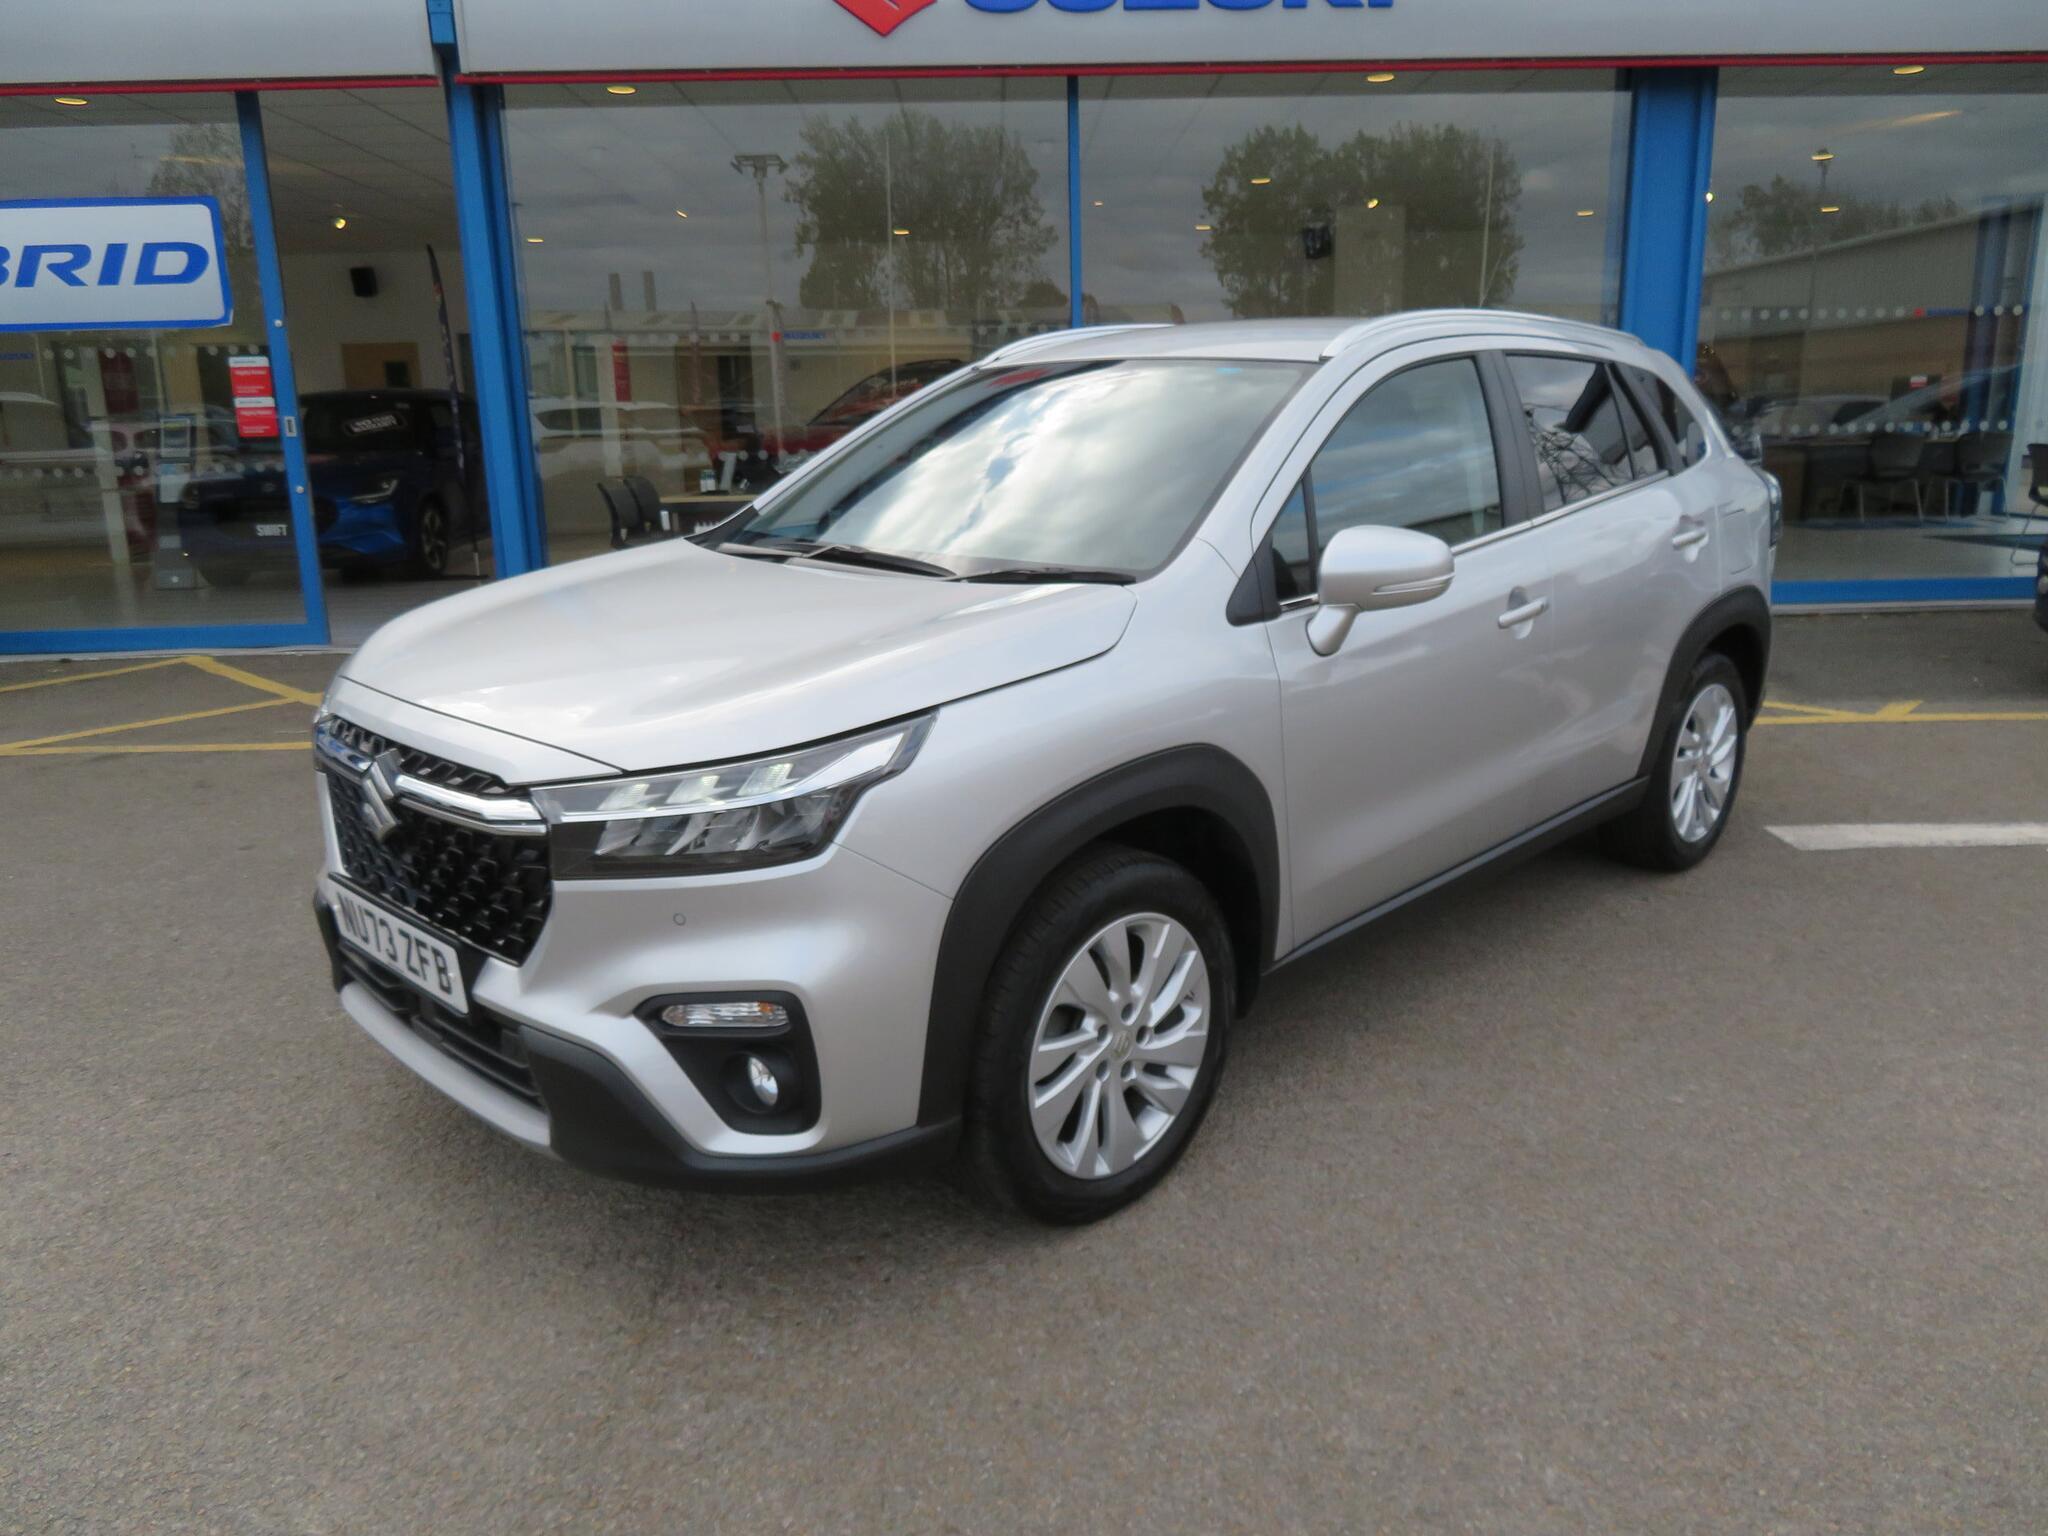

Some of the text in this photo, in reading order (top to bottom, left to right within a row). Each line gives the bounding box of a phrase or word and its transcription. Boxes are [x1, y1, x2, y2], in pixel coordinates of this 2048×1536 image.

[0, 241, 210, 288] RID
[336, 891, 453, 996] NU73 ZFB
